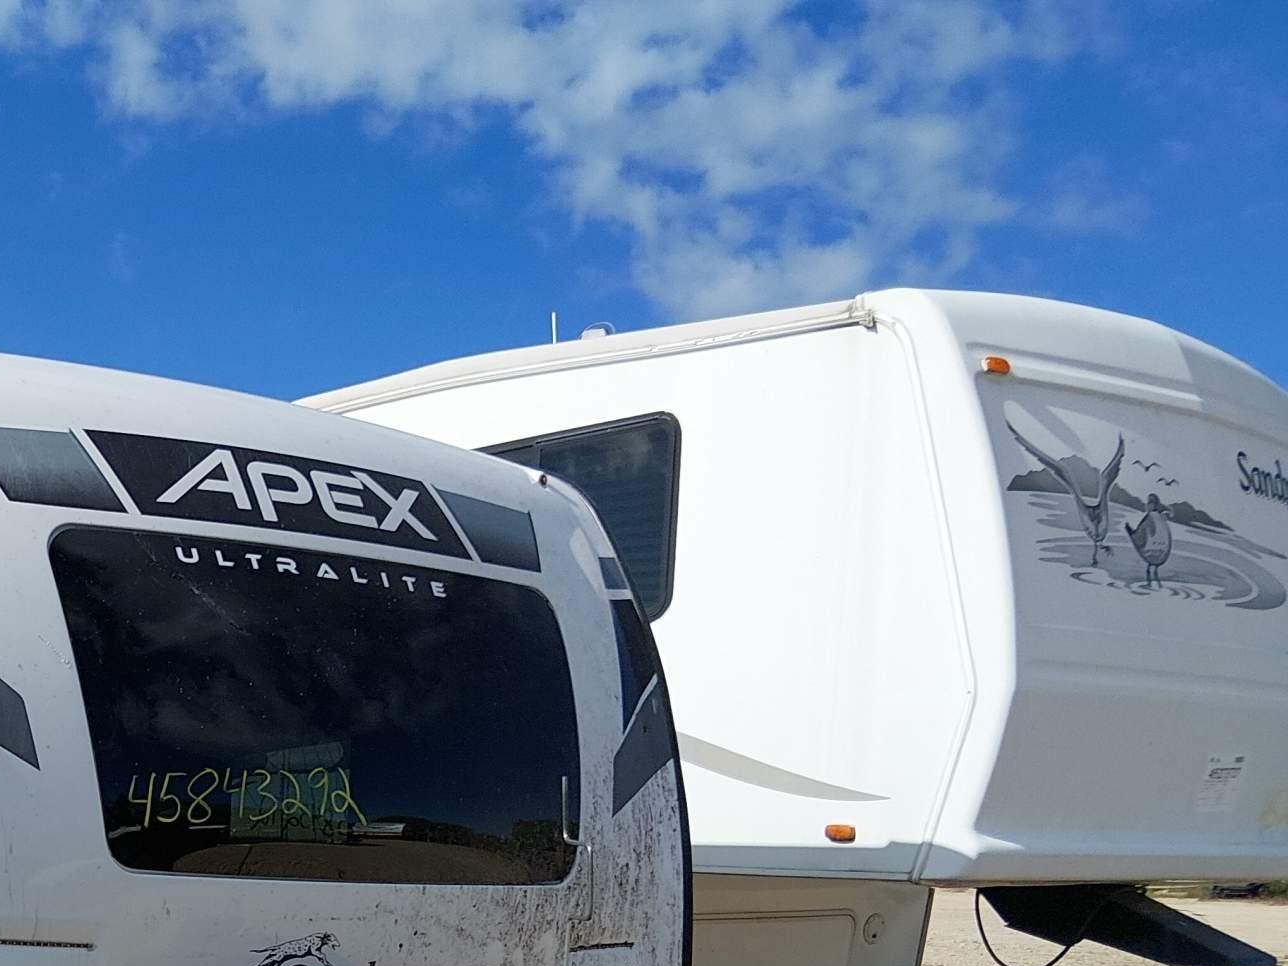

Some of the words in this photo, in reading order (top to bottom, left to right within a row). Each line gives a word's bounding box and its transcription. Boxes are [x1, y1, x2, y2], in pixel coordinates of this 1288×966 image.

[156, 448, 440, 541] APEX
[174, 546, 448, 598] ULTRALITE
[128, 767, 368, 830] 45843292
